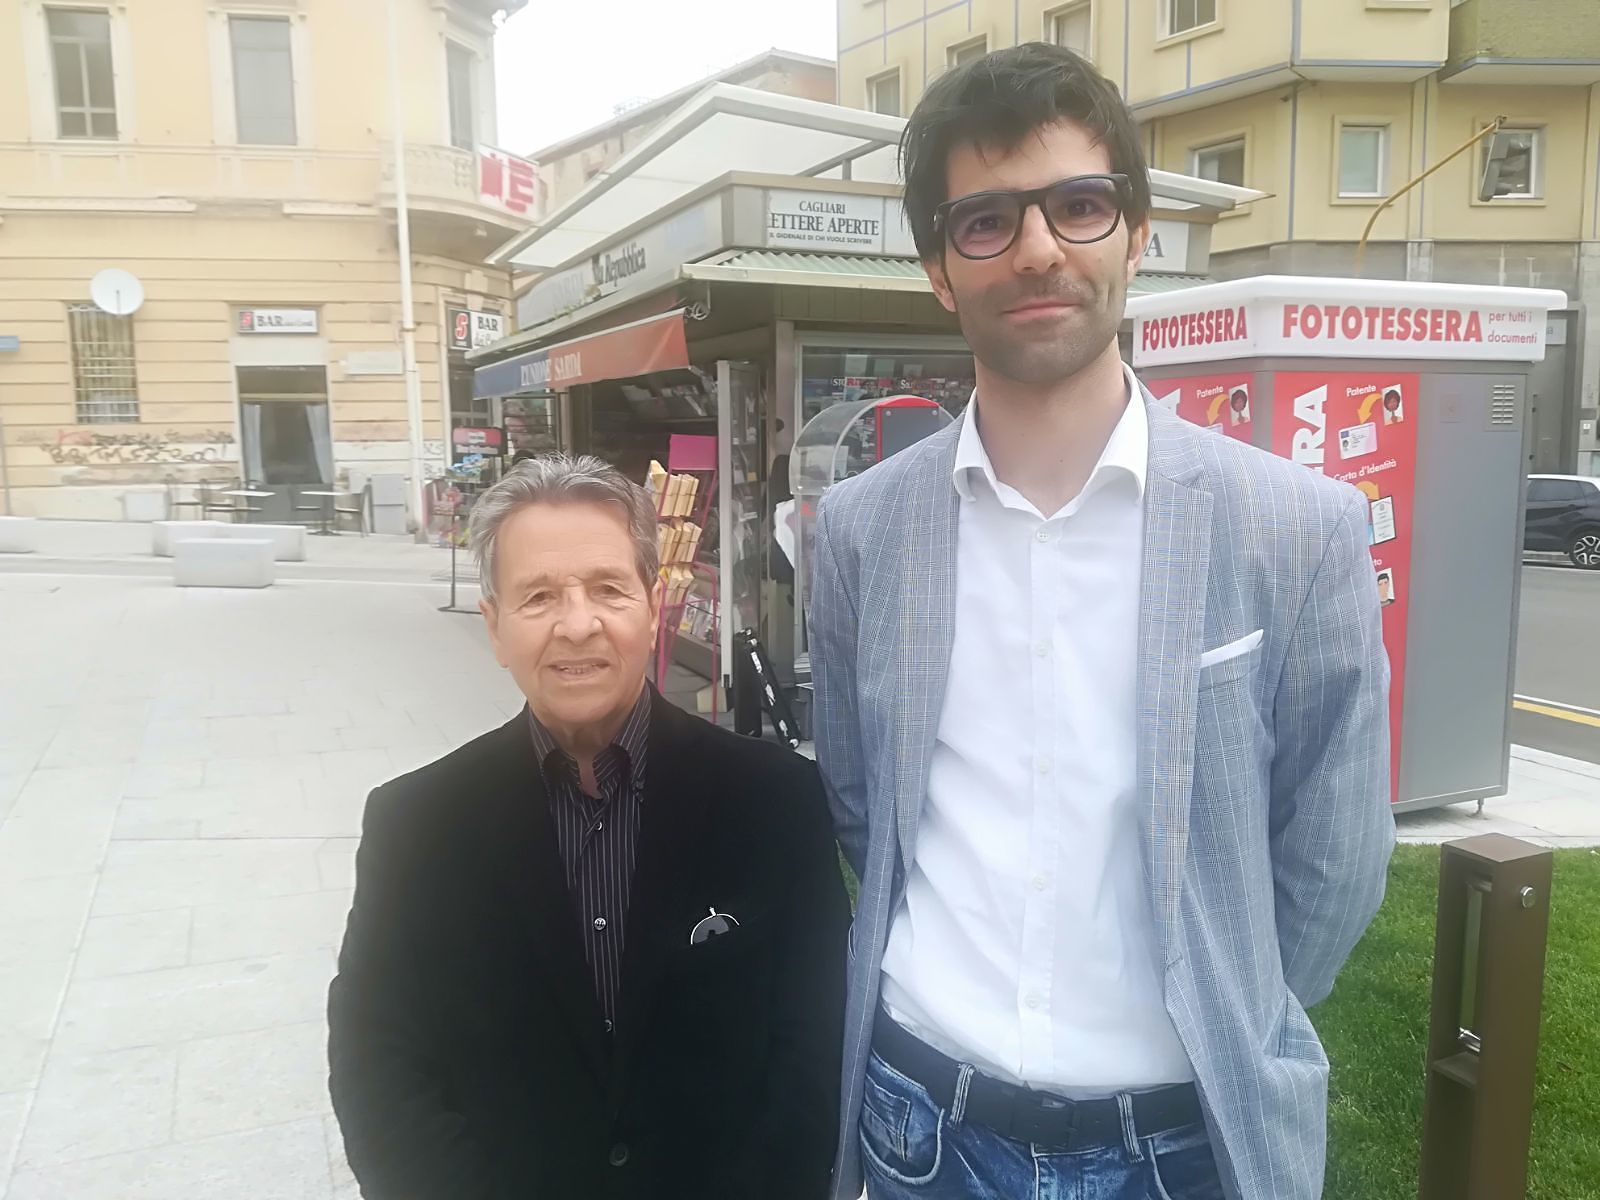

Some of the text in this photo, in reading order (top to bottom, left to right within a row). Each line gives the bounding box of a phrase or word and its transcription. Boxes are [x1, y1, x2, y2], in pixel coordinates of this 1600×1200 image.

[799, 200, 846, 214] CAGLIARI
[767, 213, 880, 236] ETTERE APERTE
[776, 232, 807, 241] GIORNALE
[847, 237, 873, 245] SCRIVERE
[256, 315, 283, 327] BAR
[477, 315, 499, 332] BAR
[1282, 304, 1483, 343] FOTOTESSERA
[1488, 310, 1507, 325] per
[1508, 309, 1527, 323] tutti
[1142, 305, 1248, 352] FOTOTESSERA
[1487, 329, 1538, 344] documenti
[1196, 385, 1224, 399] Patente
[1346, 384, 1377, 398] Patente
